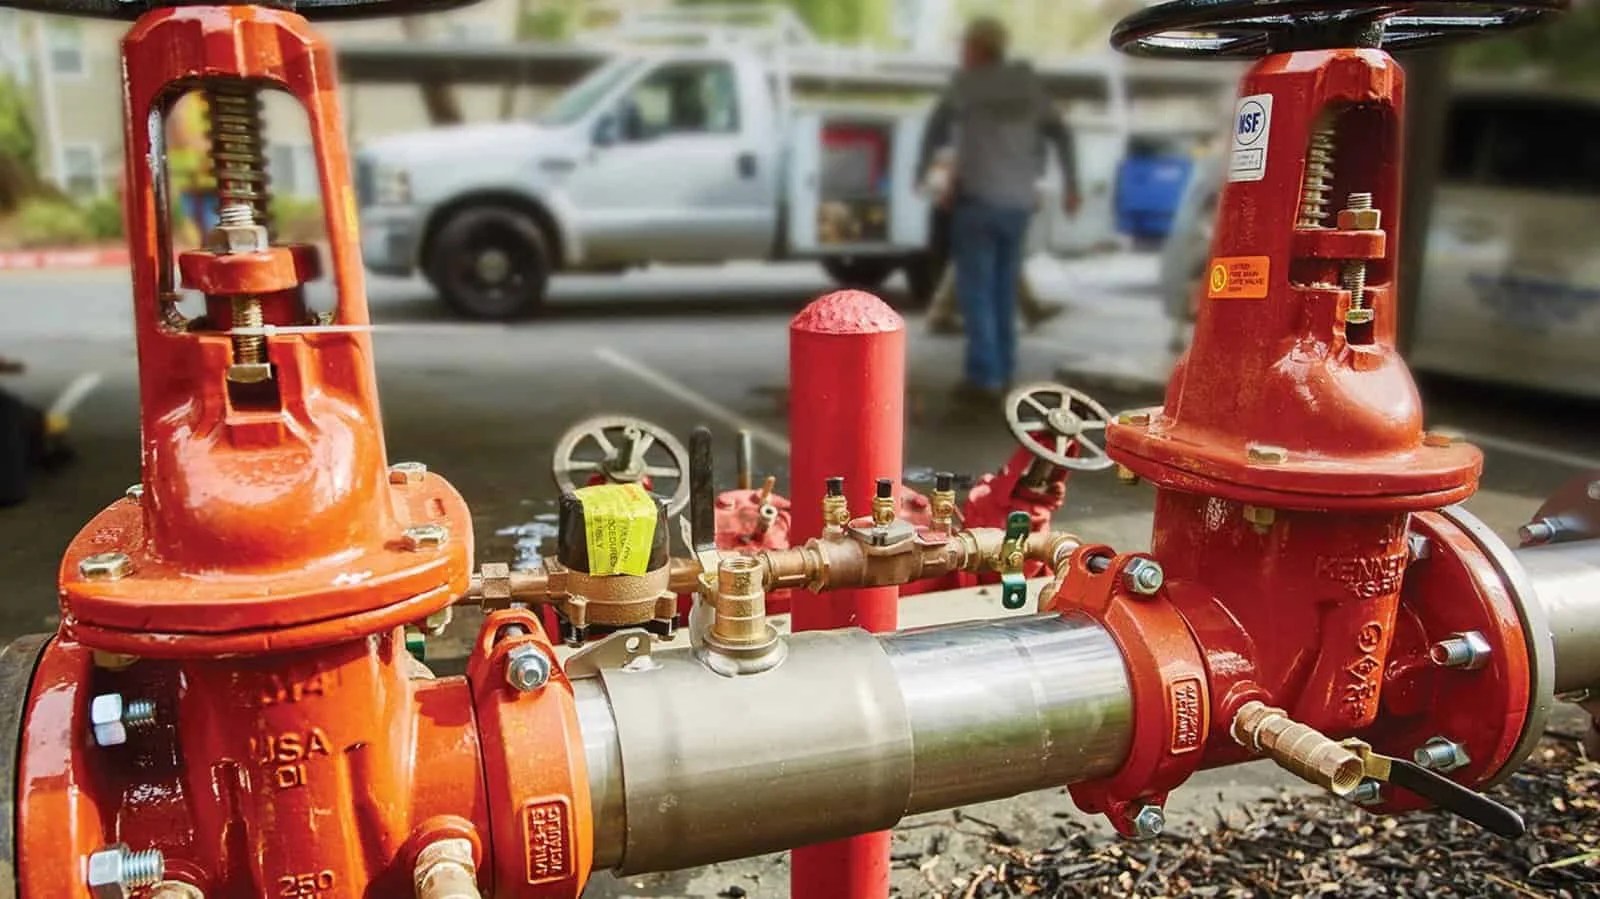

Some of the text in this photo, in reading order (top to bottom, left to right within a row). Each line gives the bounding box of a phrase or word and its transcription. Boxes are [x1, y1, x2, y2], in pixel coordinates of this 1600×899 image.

[1238, 111, 1261, 135] NSF
[250, 727, 332, 763] USA
[278, 868, 336, 896] 250
